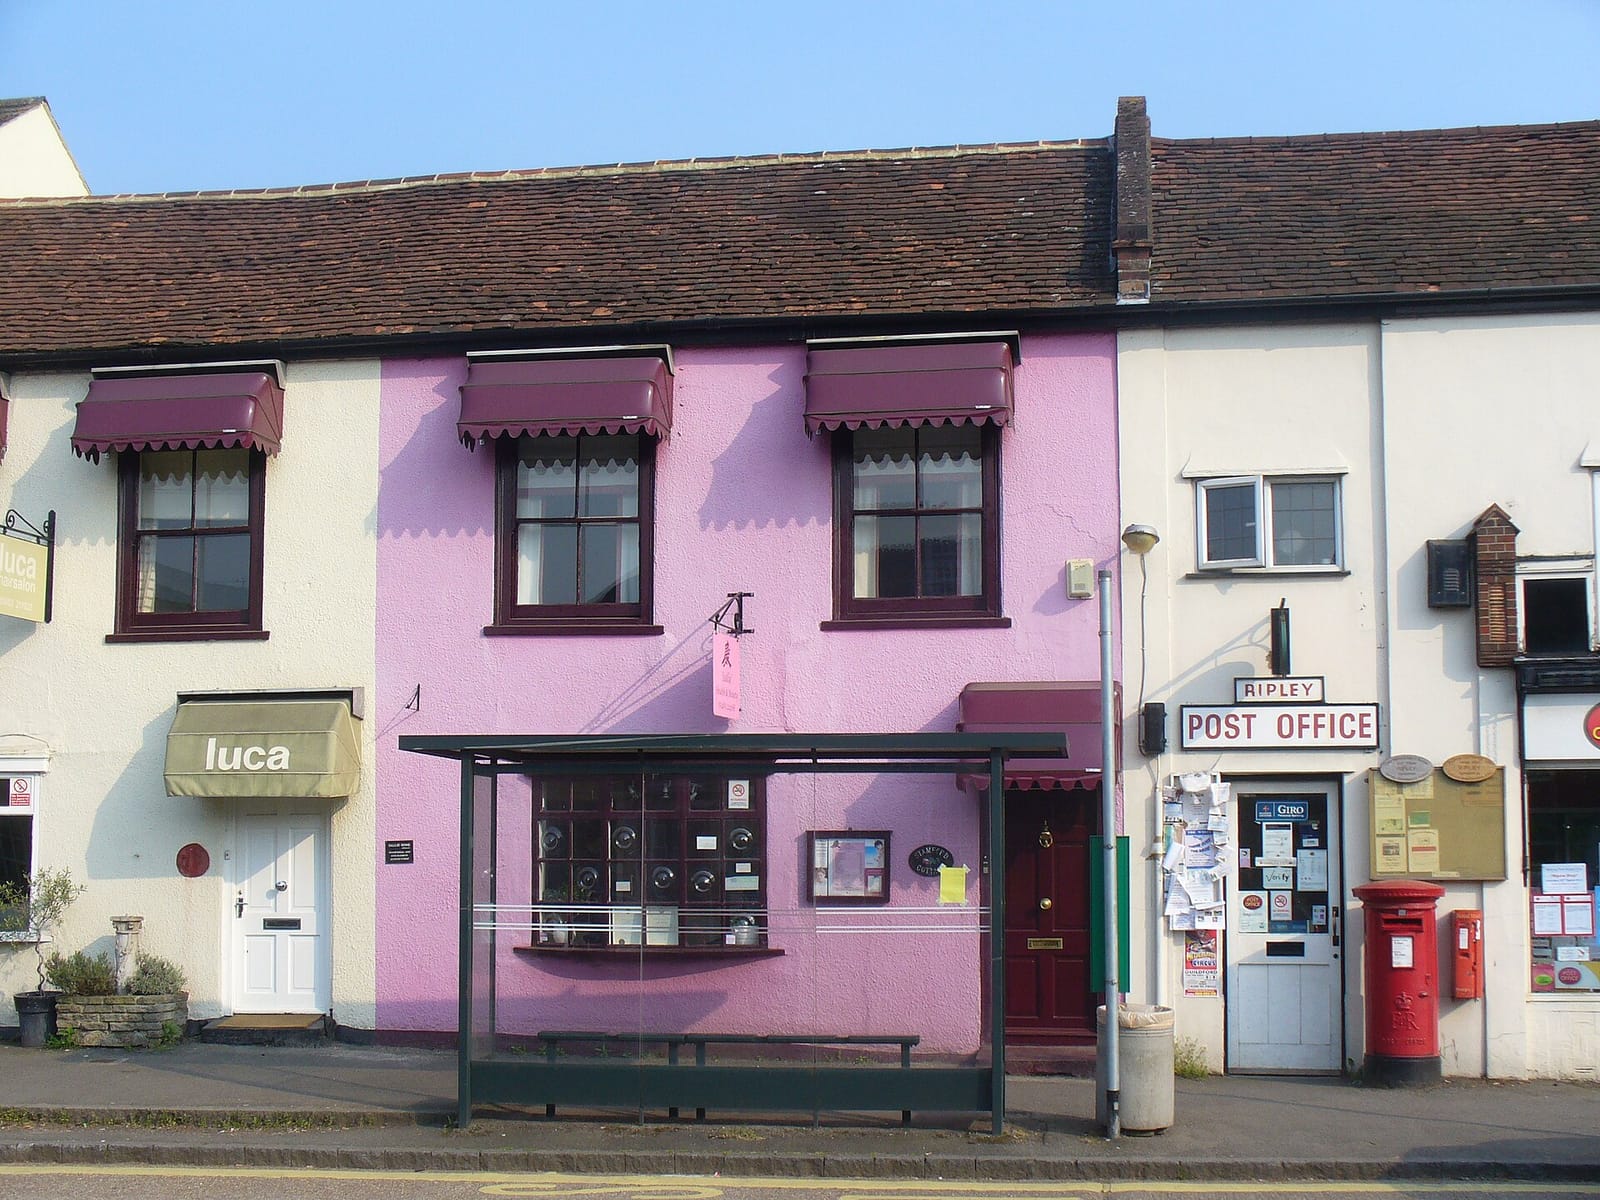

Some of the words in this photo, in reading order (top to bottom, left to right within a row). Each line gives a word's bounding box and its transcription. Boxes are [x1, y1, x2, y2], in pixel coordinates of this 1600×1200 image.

[1244, 683, 1314, 697] RIPLEY
[1188, 713, 1257, 739] POST
[1276, 713, 1372, 739] OFFICE
[205, 737, 290, 771] luca
[1277, 804, 1305, 815] GIRO
